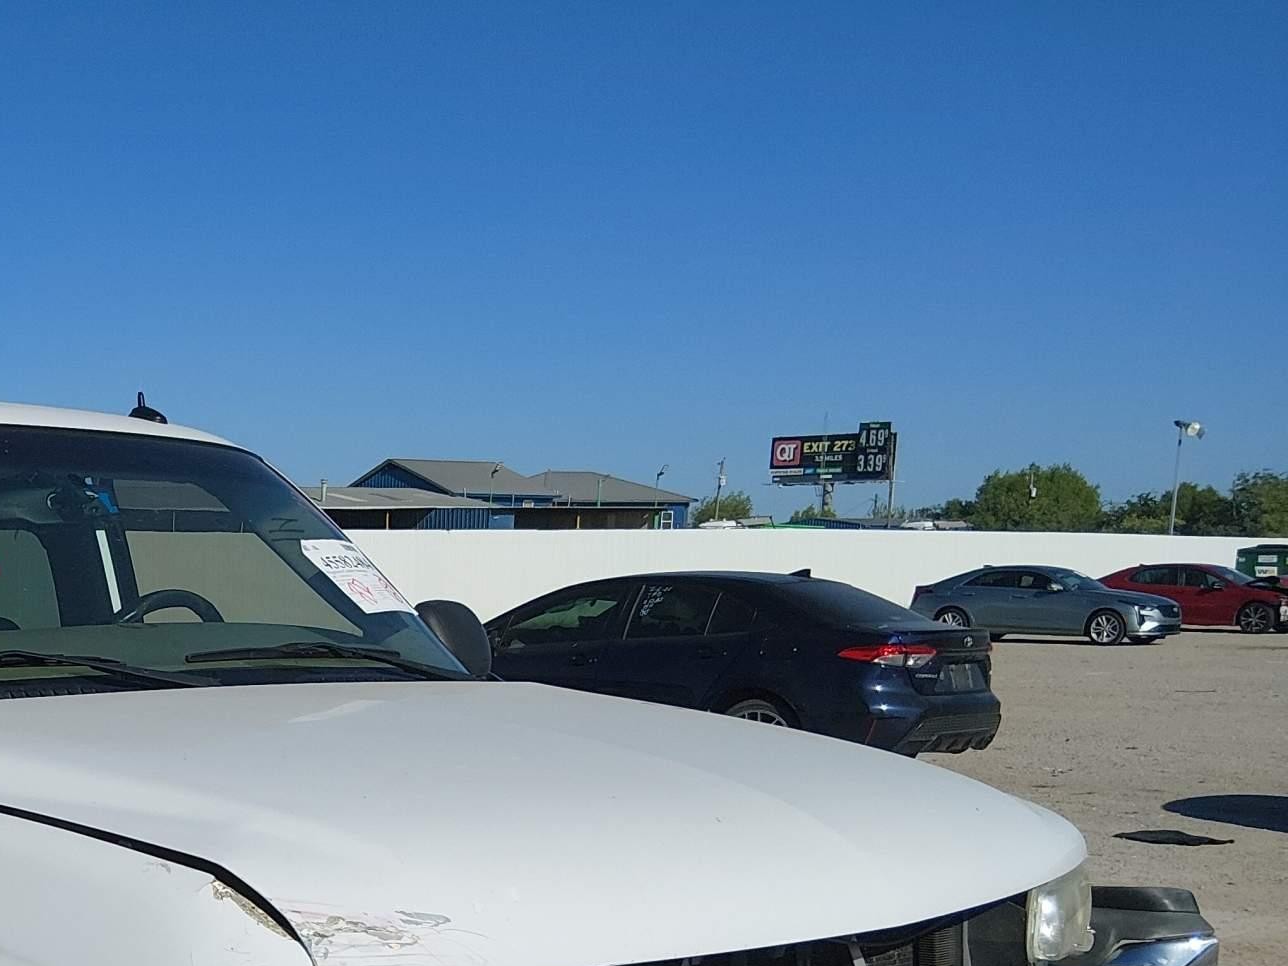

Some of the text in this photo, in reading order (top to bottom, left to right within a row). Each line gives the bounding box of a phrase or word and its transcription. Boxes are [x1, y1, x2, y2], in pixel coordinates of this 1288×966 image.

[776, 444, 797, 461] QT
[803, 441, 831, 453] EXIT
[833, 440, 856, 452] 273
